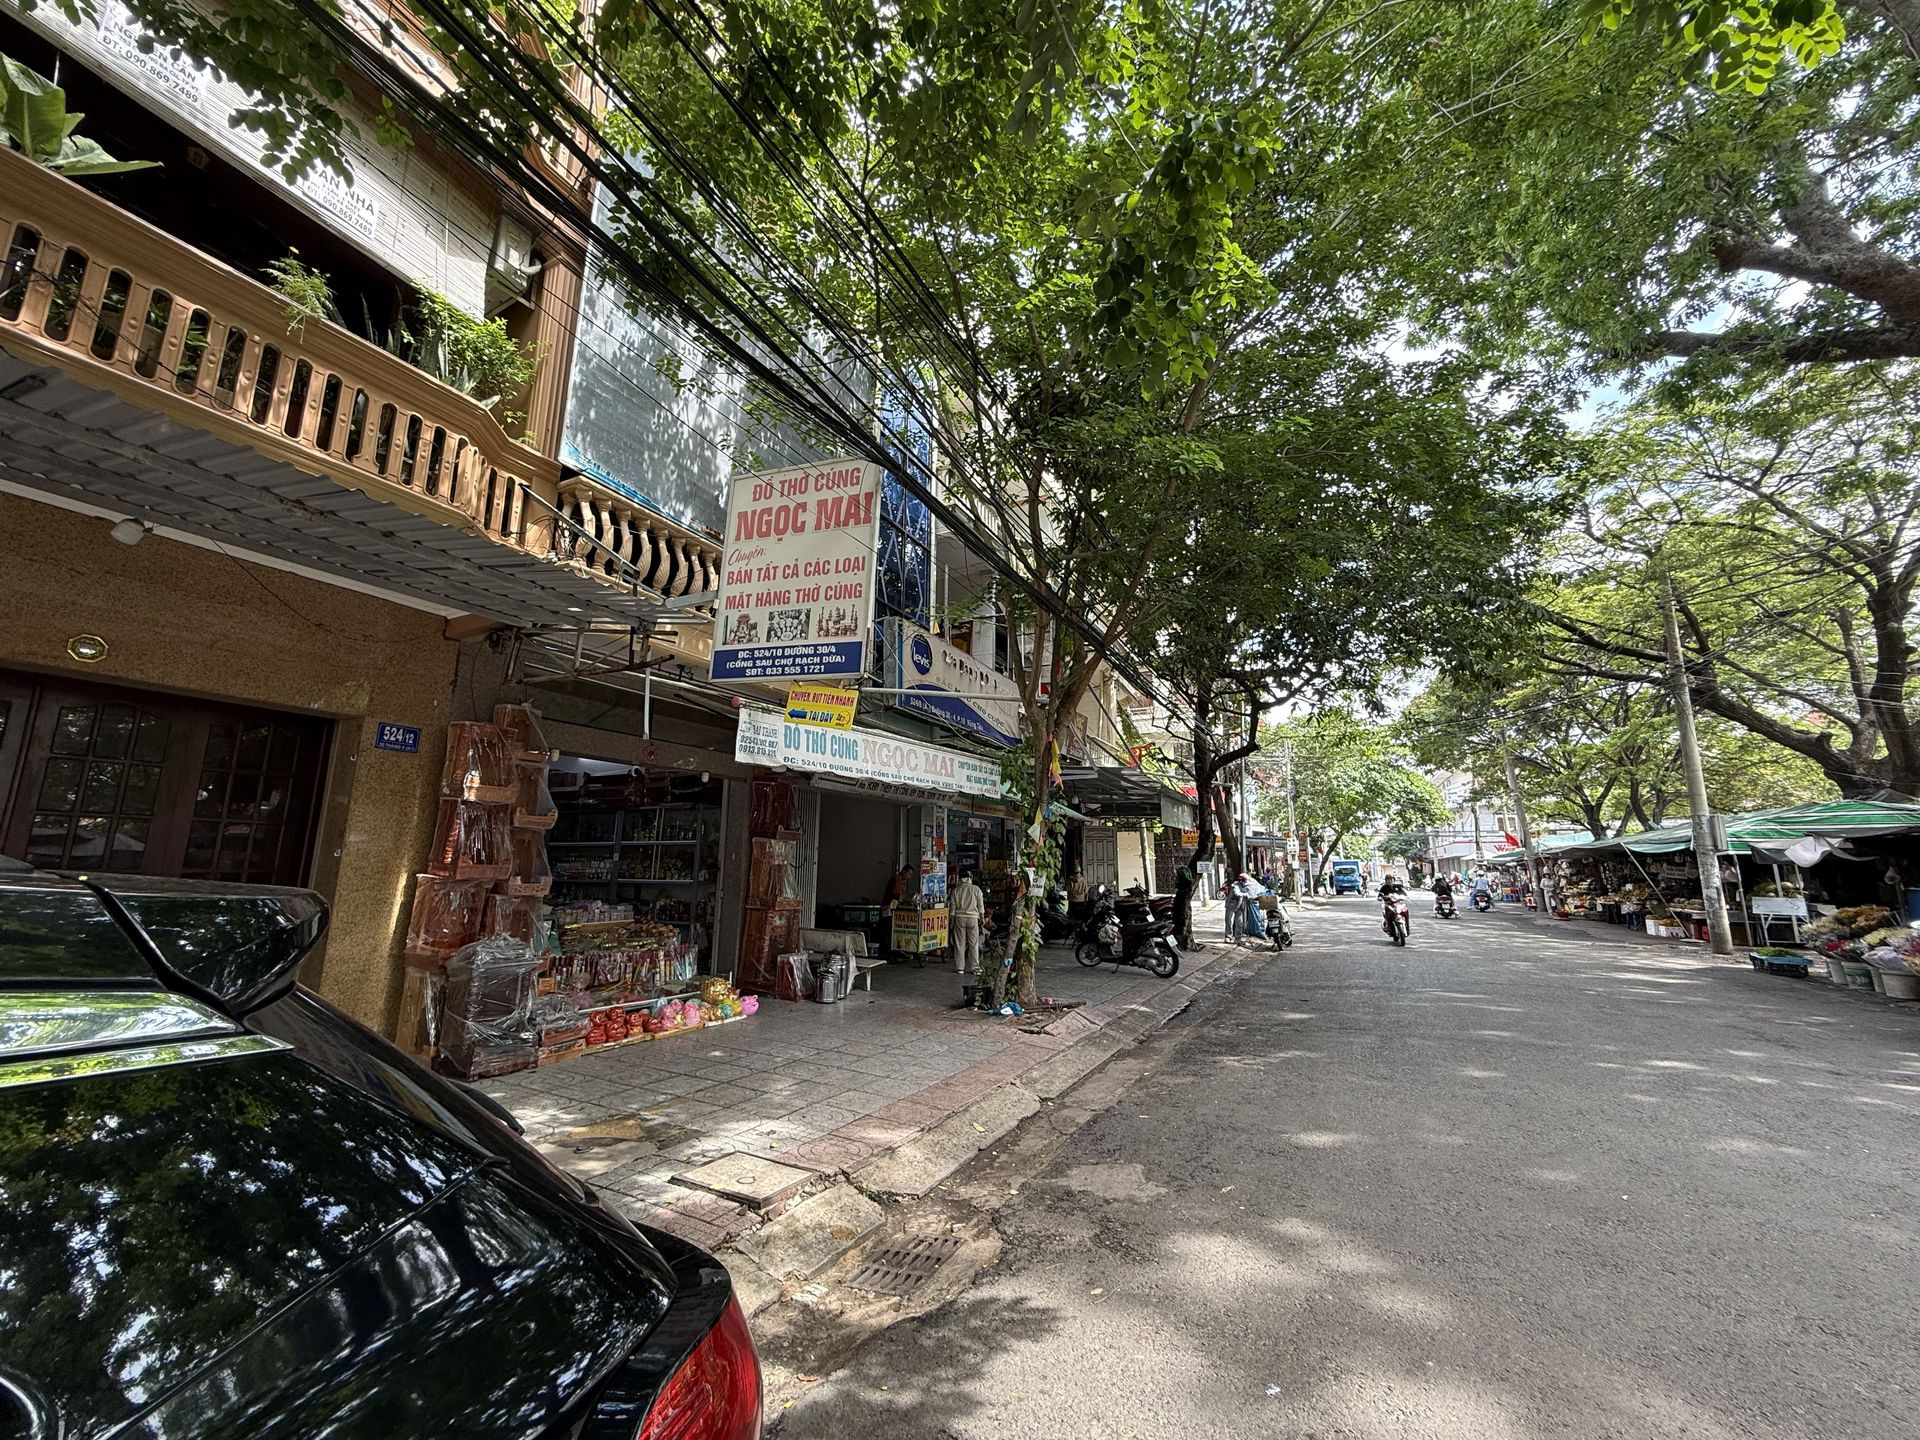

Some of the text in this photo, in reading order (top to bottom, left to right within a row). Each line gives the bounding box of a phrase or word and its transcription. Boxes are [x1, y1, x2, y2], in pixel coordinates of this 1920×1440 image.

[125, 50, 199, 103] 090.869.7489
[322, 196, 373, 235] 090.869.7489
[752, 467, 861, 502] ĐỒ THỜ CÚNG
[734, 491, 874, 542] NGỌC MAI
[726, 555, 866, 585] BÁN TẤT CẢ CÁC LOẠI
[725, 581, 863, 613] MẶT HÀNG THỜ CÚNG
[753, 648, 782, 658] 524/10
[784, 645, 815, 656] ĐƯỜNG
[816, 645, 836, 654] 30/4
[755, 658, 773, 667] SAU
[774, 658, 794, 667] CHỢ
[795, 656, 820, 667] RẠCH
[822, 654, 846, 664] DỪA)
[745, 665, 825, 677] SĐT: 033 555 1721
[383, 726, 415, 744] 524/12
[801, 759, 827, 769] 524/10
[804, 728, 828, 756] THỜ
[830, 733, 858, 761] CÚNG
[862, 739, 919, 774] NGỌC
[923, 751, 955, 778] MAI
